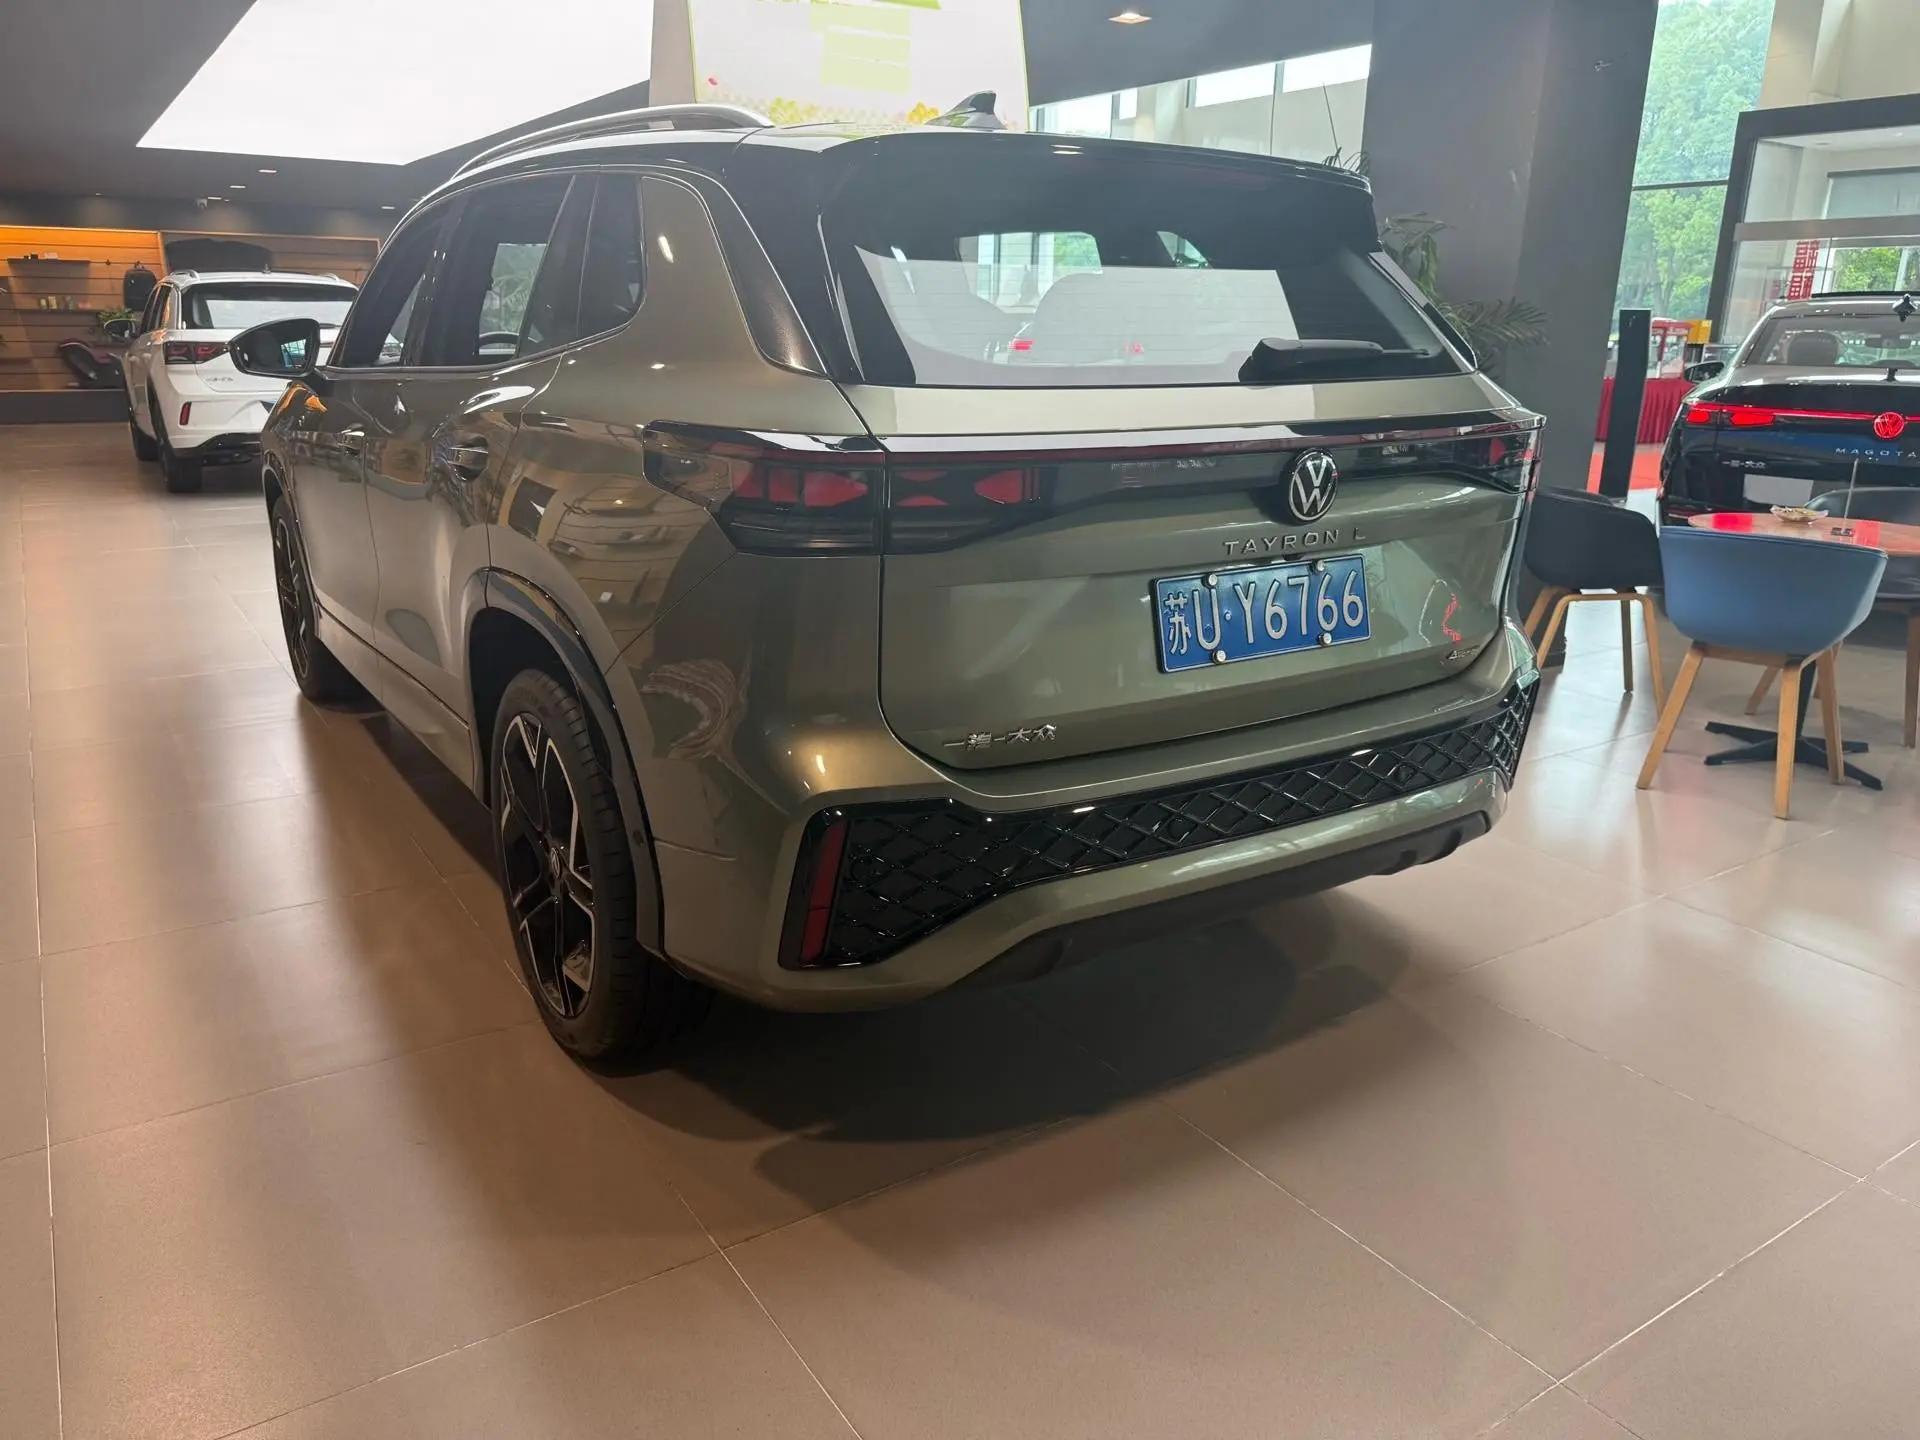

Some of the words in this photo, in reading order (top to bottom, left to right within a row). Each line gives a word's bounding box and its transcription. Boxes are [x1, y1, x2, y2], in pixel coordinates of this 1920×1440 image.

[1225, 529, 1339, 555] TAYRON
[1354, 527, 1366, 540] L
[1164, 569, 1364, 655] 苏U·Y6766
